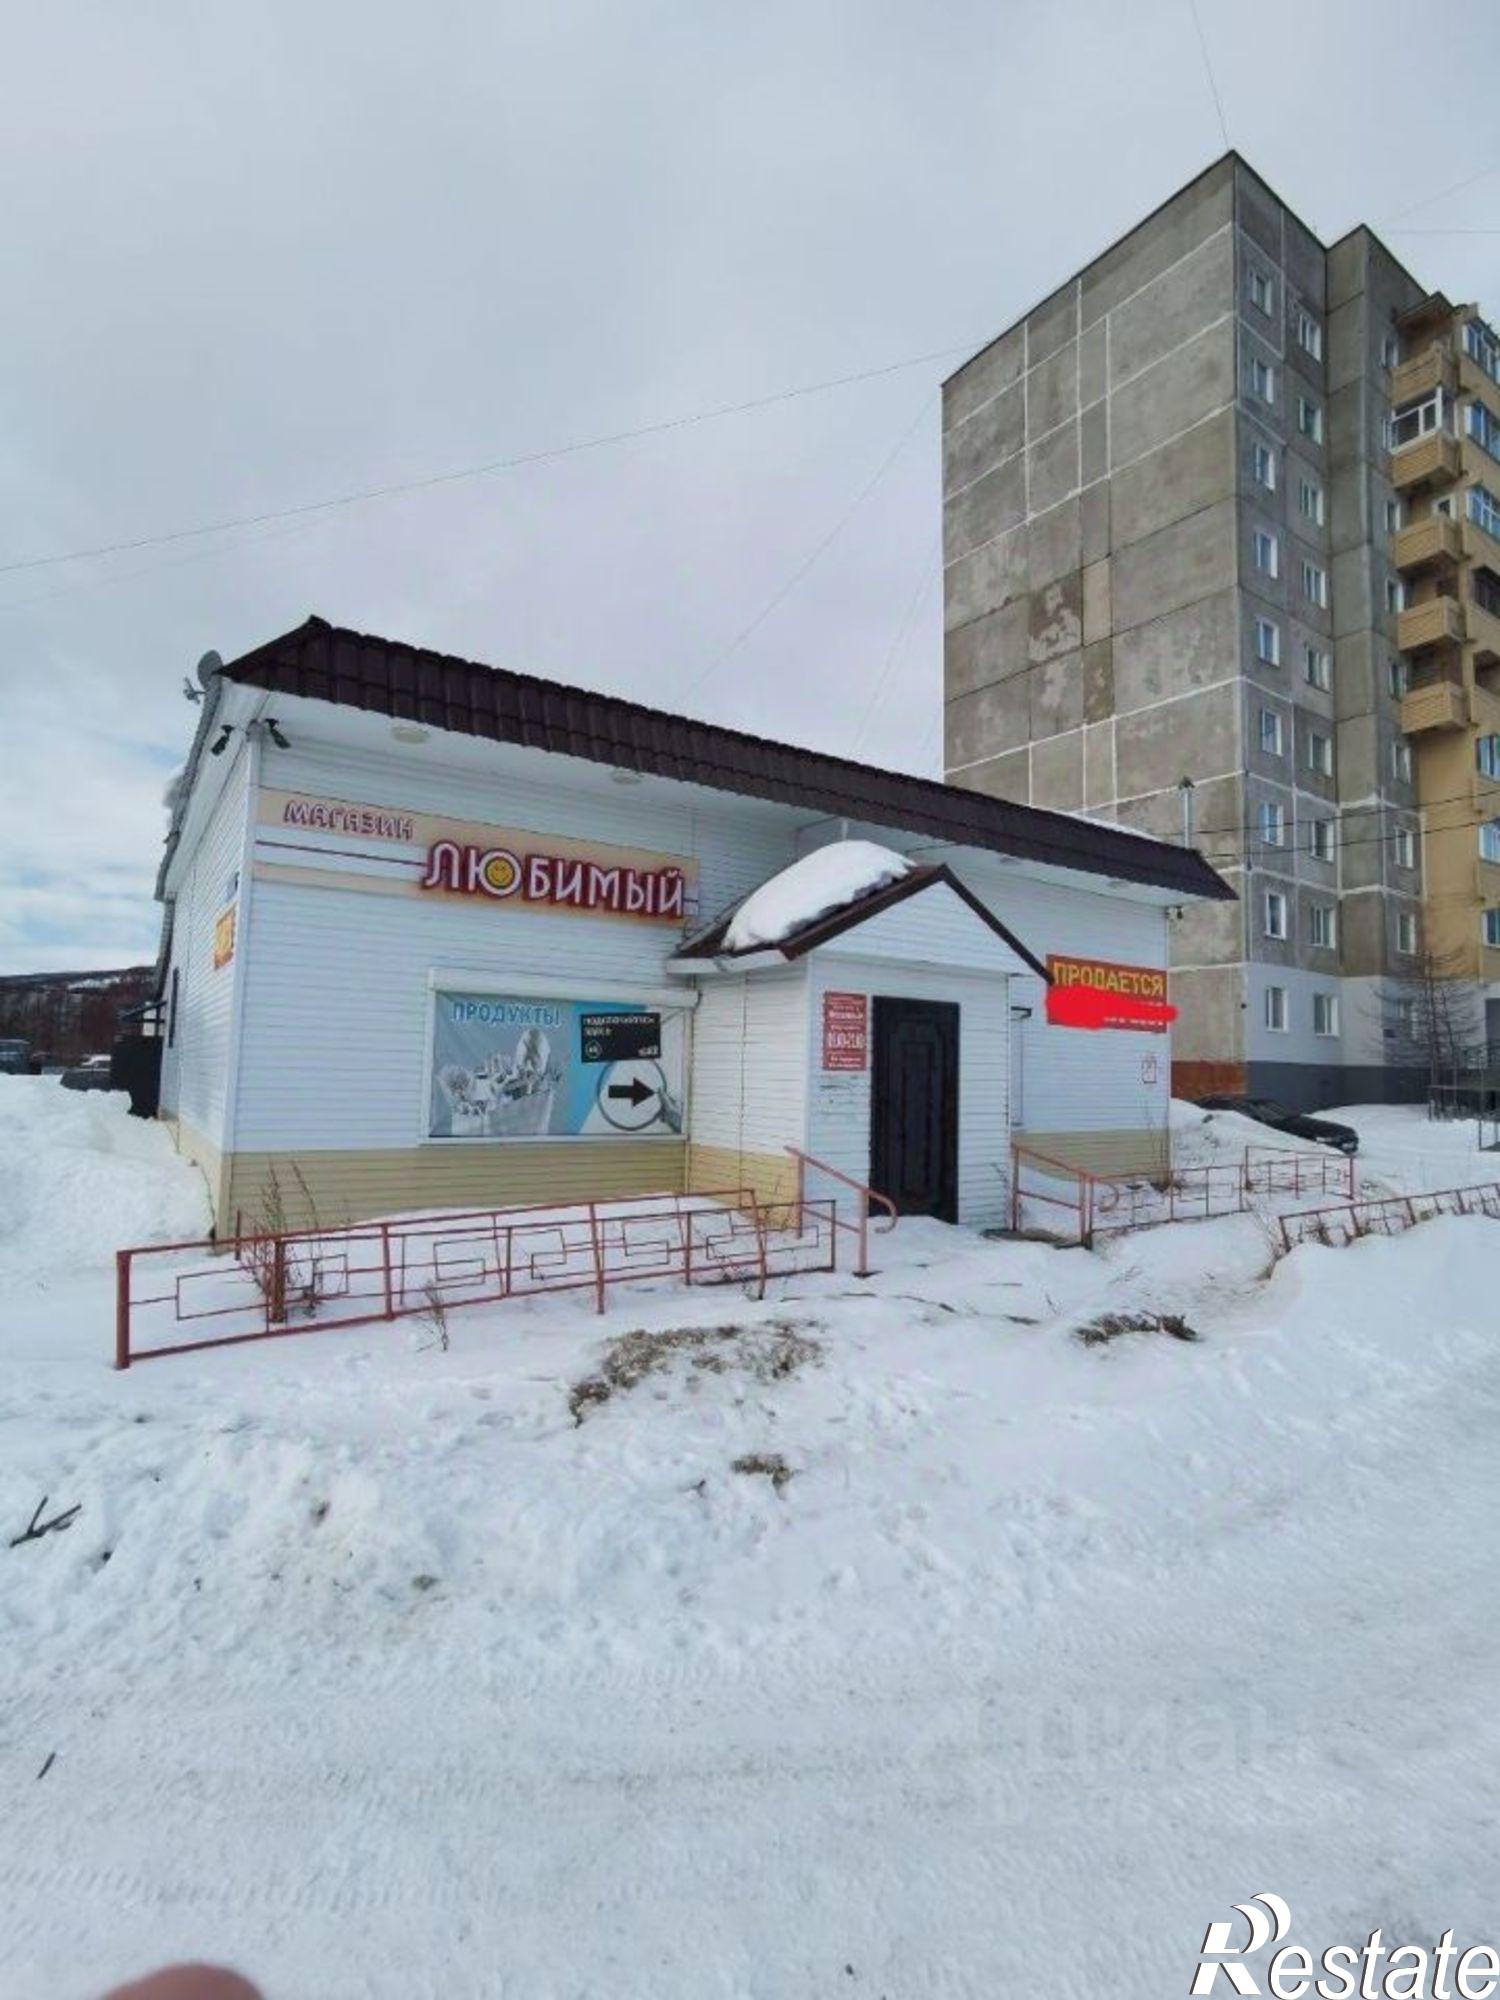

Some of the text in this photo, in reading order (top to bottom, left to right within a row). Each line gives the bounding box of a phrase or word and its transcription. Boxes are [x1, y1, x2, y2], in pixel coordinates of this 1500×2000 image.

[283, 801, 414, 840] МАГАЗИН
[422, 840, 685, 918] ЛЮБИМЫЙ
[1053, 961, 1164, 997] ПРОДАЕТСЯ
[451, 1001, 561, 1028] ПРОДУКТЫ
